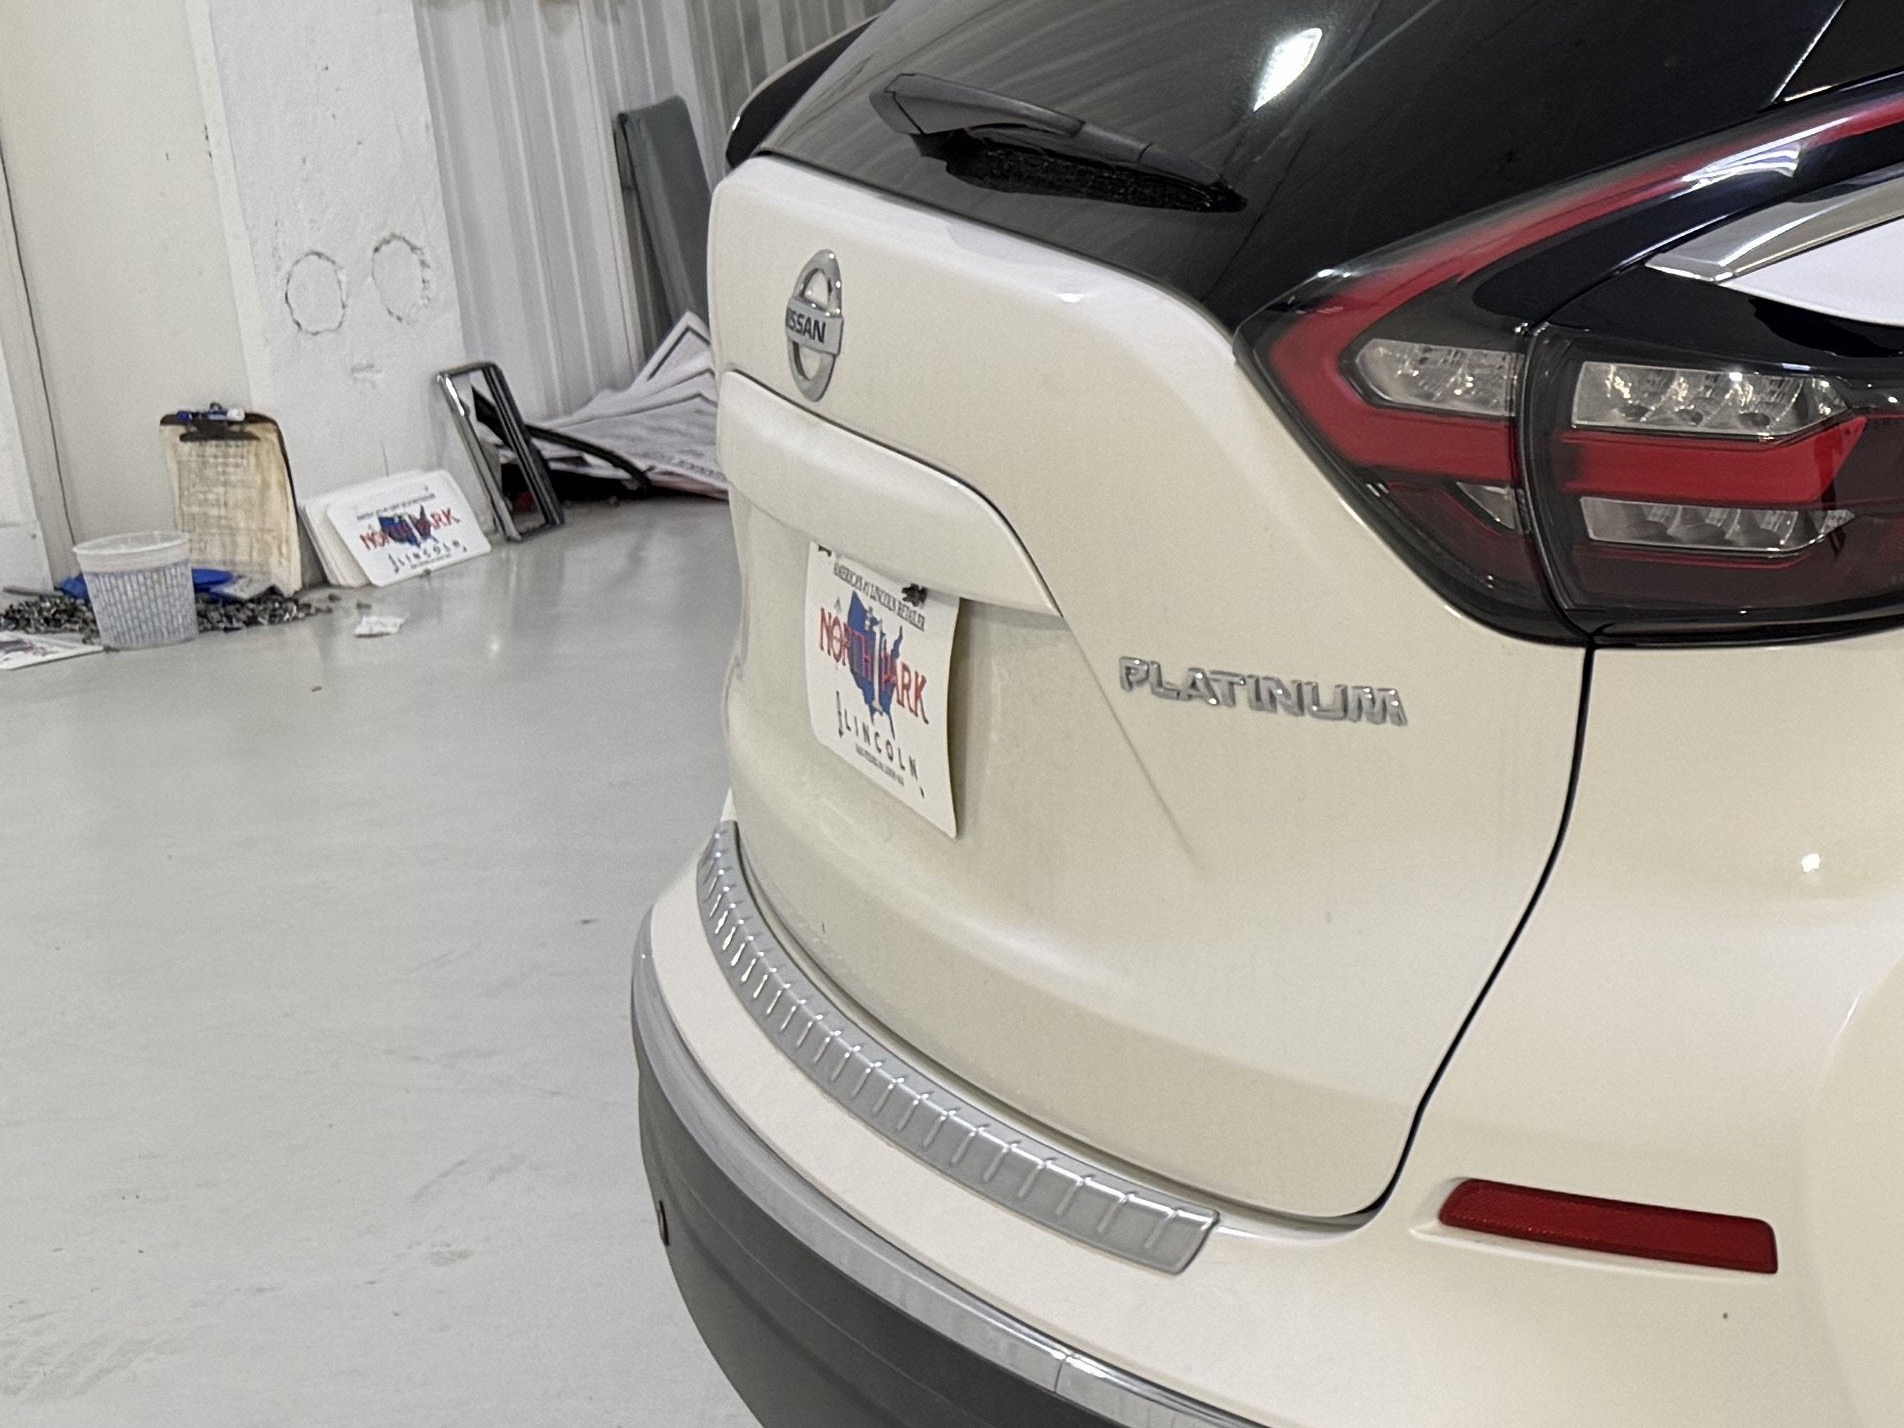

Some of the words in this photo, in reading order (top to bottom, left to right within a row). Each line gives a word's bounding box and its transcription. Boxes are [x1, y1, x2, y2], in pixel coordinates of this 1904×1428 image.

[820, 607, 873, 682] NORTH
[1119, 656, 1408, 726] PLATINUM
[844, 708, 918, 780] LINCOLN
